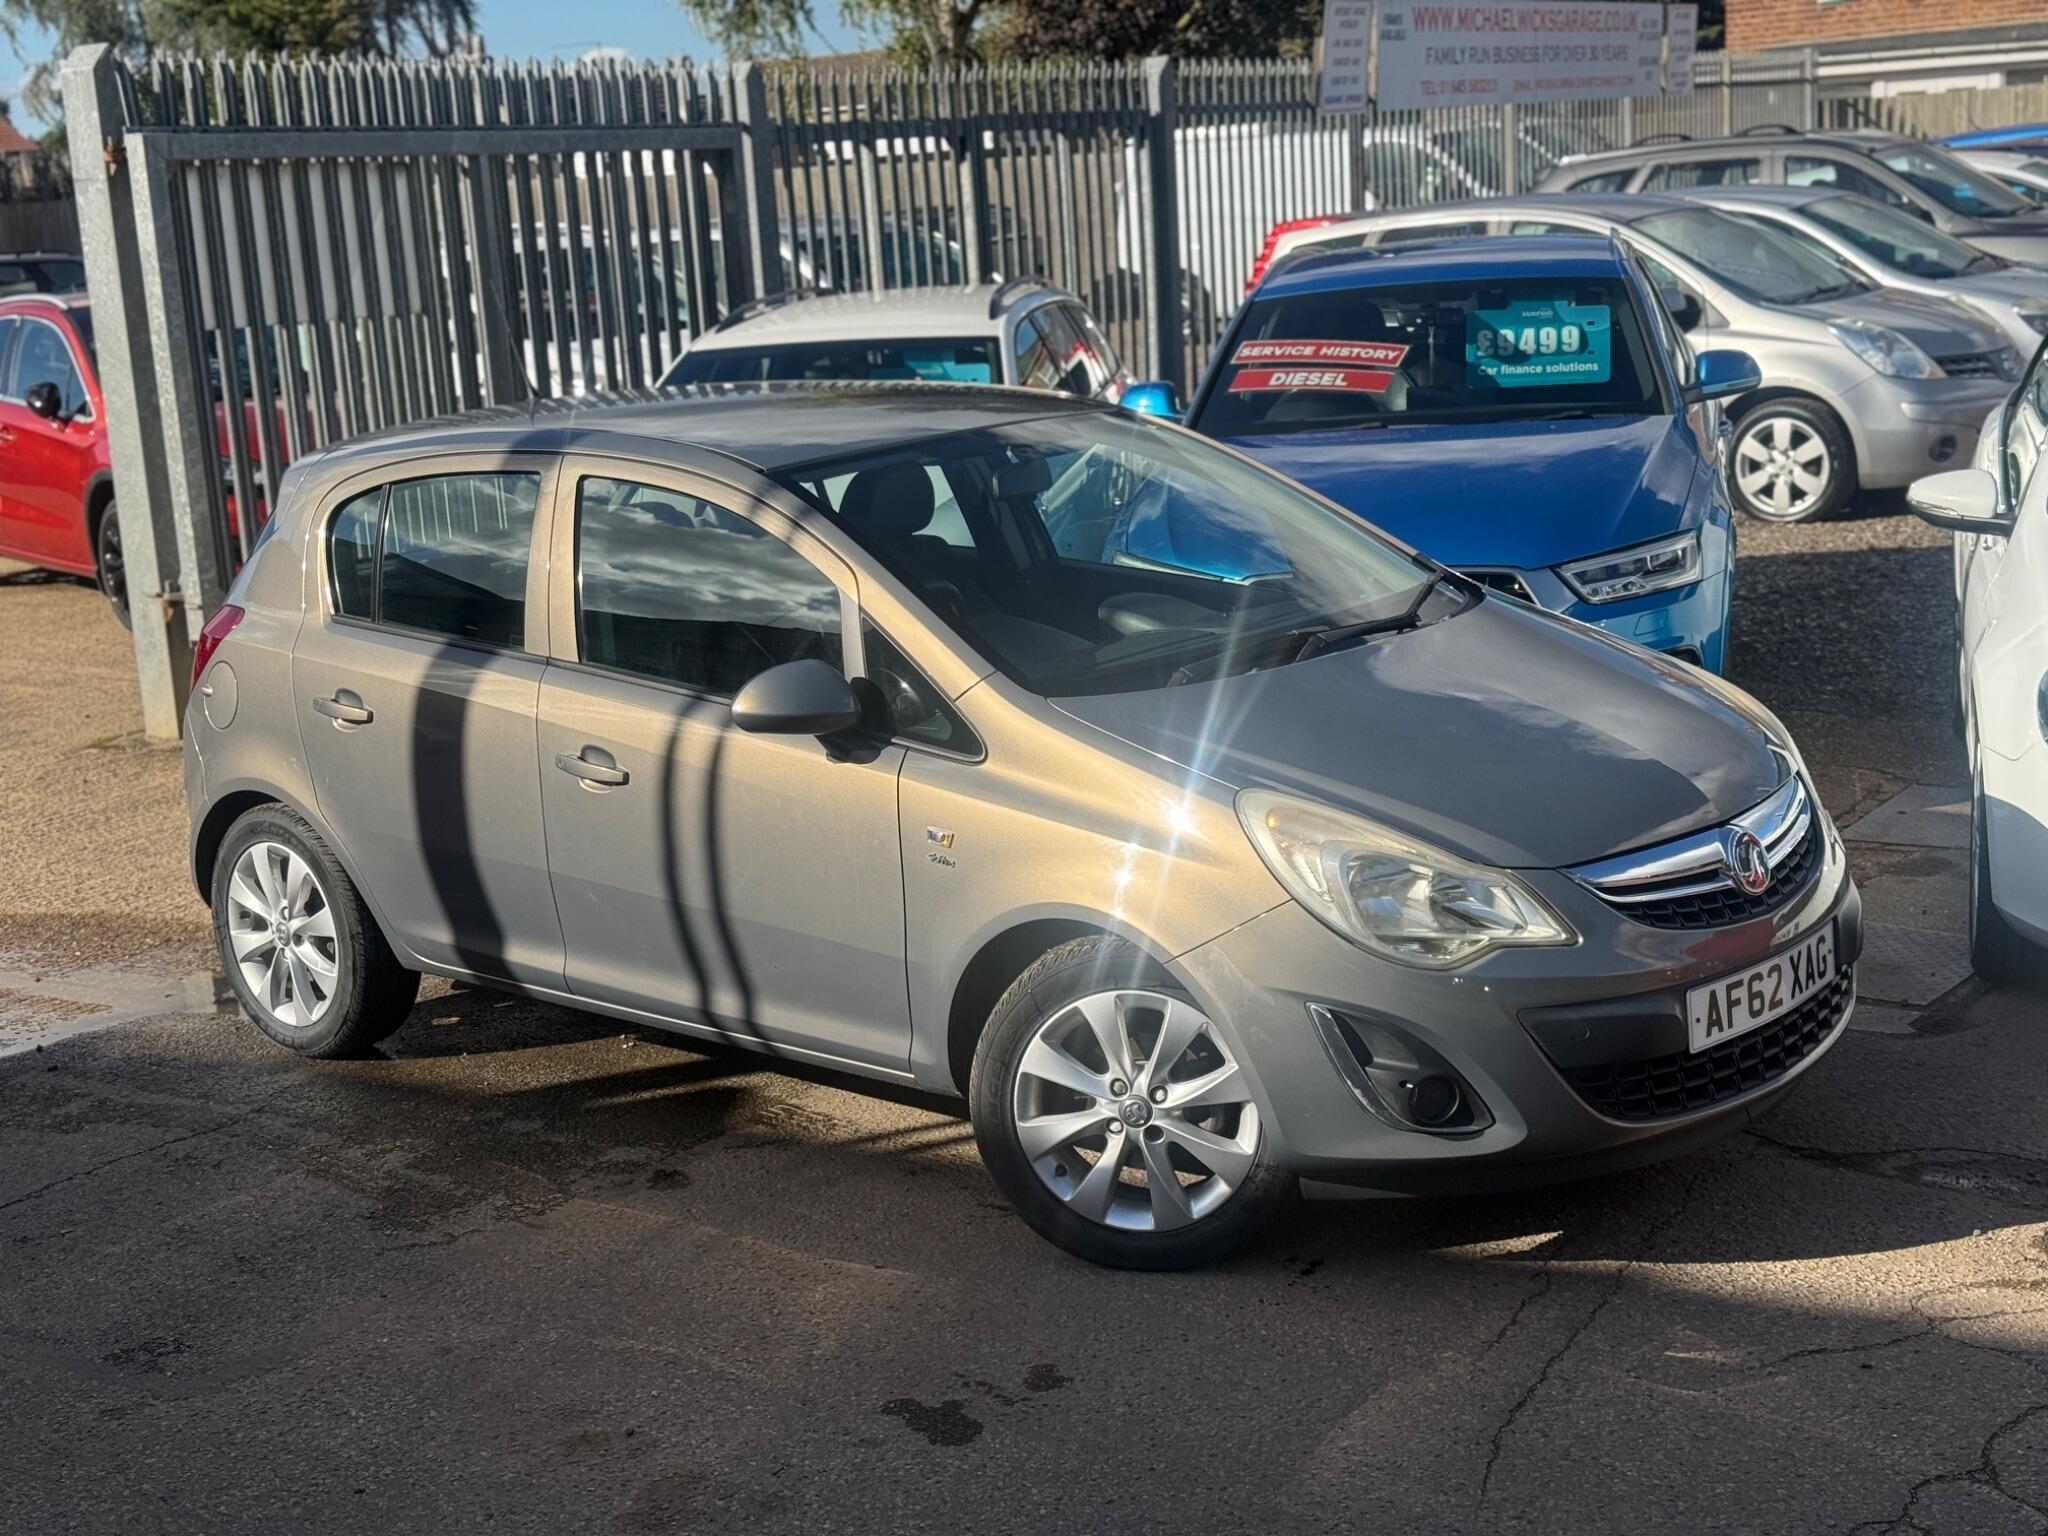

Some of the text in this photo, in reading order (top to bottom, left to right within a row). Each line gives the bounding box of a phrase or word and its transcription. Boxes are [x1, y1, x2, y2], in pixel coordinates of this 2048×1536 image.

[1425, 46, 1467, 66] FAMILY
[1493, 45, 1541, 64] BUSINESS
[1477, 325, 1580, 357] £9499
[1239, 345, 1400, 360] SERVICE HISTORY
[1478, 362, 1599, 376] Car finance solutions
[1268, 372, 1348, 387] DIESEL
[1706, 934, 1828, 1038] AF62 XAG
